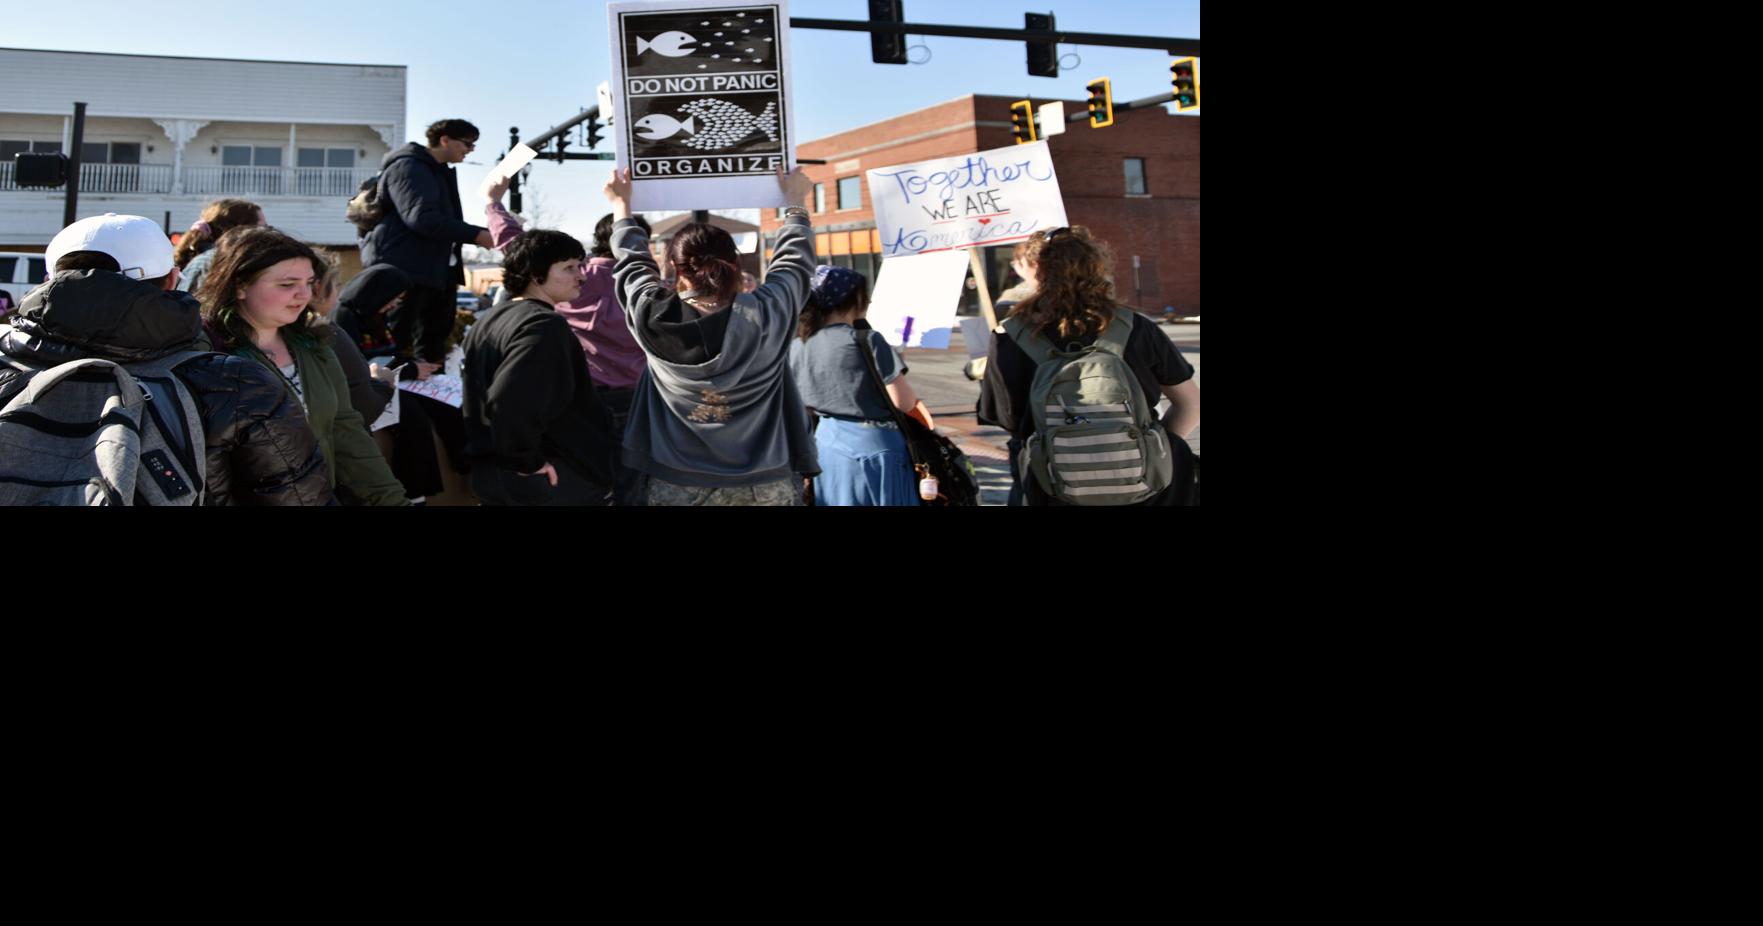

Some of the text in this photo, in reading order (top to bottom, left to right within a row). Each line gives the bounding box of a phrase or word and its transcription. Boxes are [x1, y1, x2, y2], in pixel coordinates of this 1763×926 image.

[631, 73, 777, 95] DO NOT PANIC
[636, 156, 782, 175] ORGANIZE
[872, 157, 1053, 204] Together
[922, 188, 1010, 220] WE ARE
